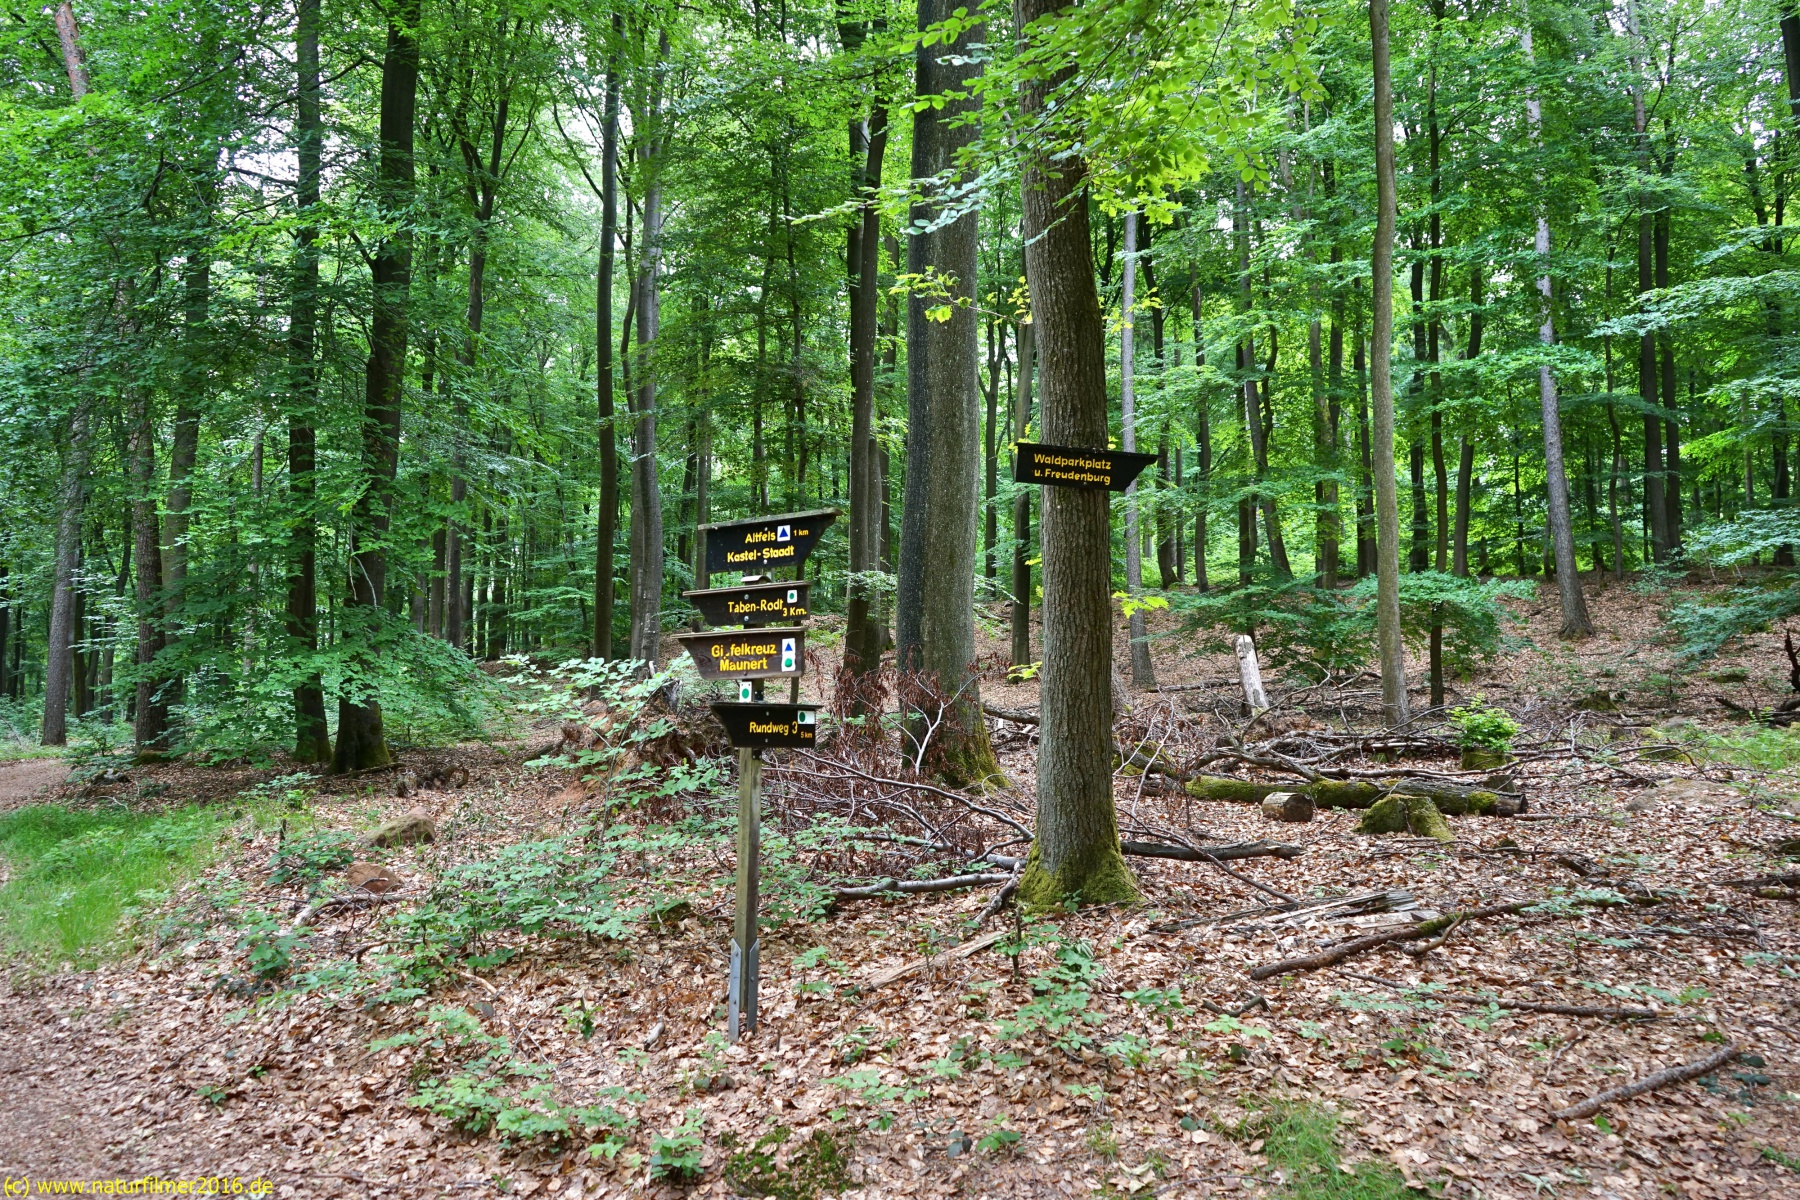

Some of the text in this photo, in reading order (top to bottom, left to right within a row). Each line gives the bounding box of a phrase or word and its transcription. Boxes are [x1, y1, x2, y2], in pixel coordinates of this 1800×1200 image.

[1033, 453, 1111, 470] Waldparkplatz
[1034, 468, 1111, 486] u. Freudenburg
[744, 530, 776, 544] Altfels
[727, 545, 795, 563] Kastel-Staadt
[728, 598, 783, 613] Taben-Rodt
[782, 608, 788, 617] 3
[711, 643, 777, 658] Gifelkreuz
[719, 657, 768, 671] Maunert
[749, 721, 798, 736] Rundweg 3
[805, 731, 813, 739] km
